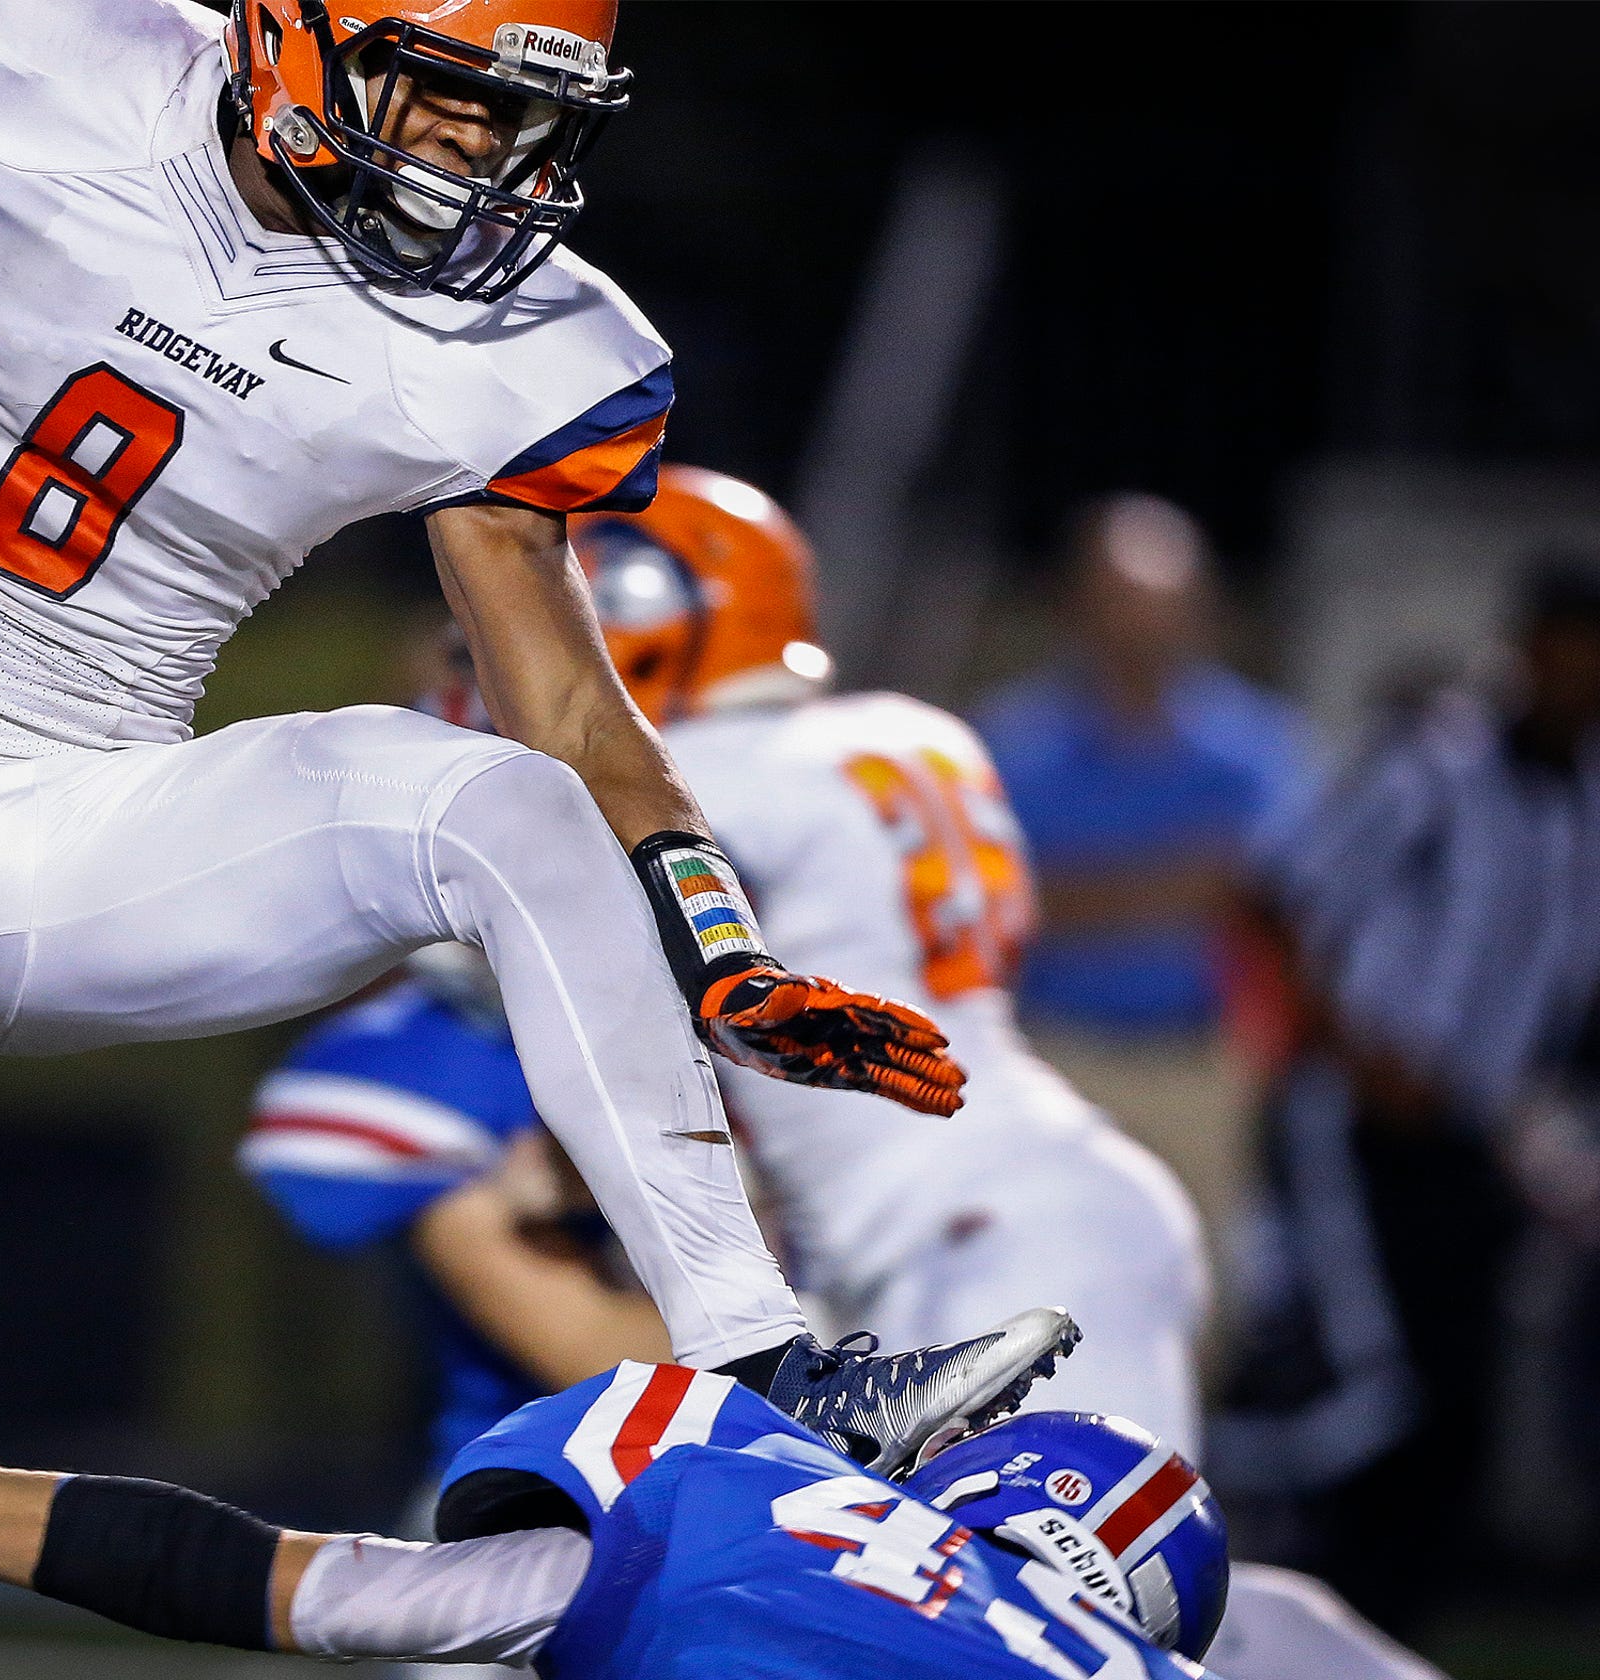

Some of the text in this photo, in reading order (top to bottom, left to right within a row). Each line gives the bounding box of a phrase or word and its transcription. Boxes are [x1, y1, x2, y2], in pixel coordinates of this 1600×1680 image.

[523, 30, 582, 61] Riddell
[115, 307, 265, 400] RIDGEWAY
[1051, 1473, 1089, 1501] 45
